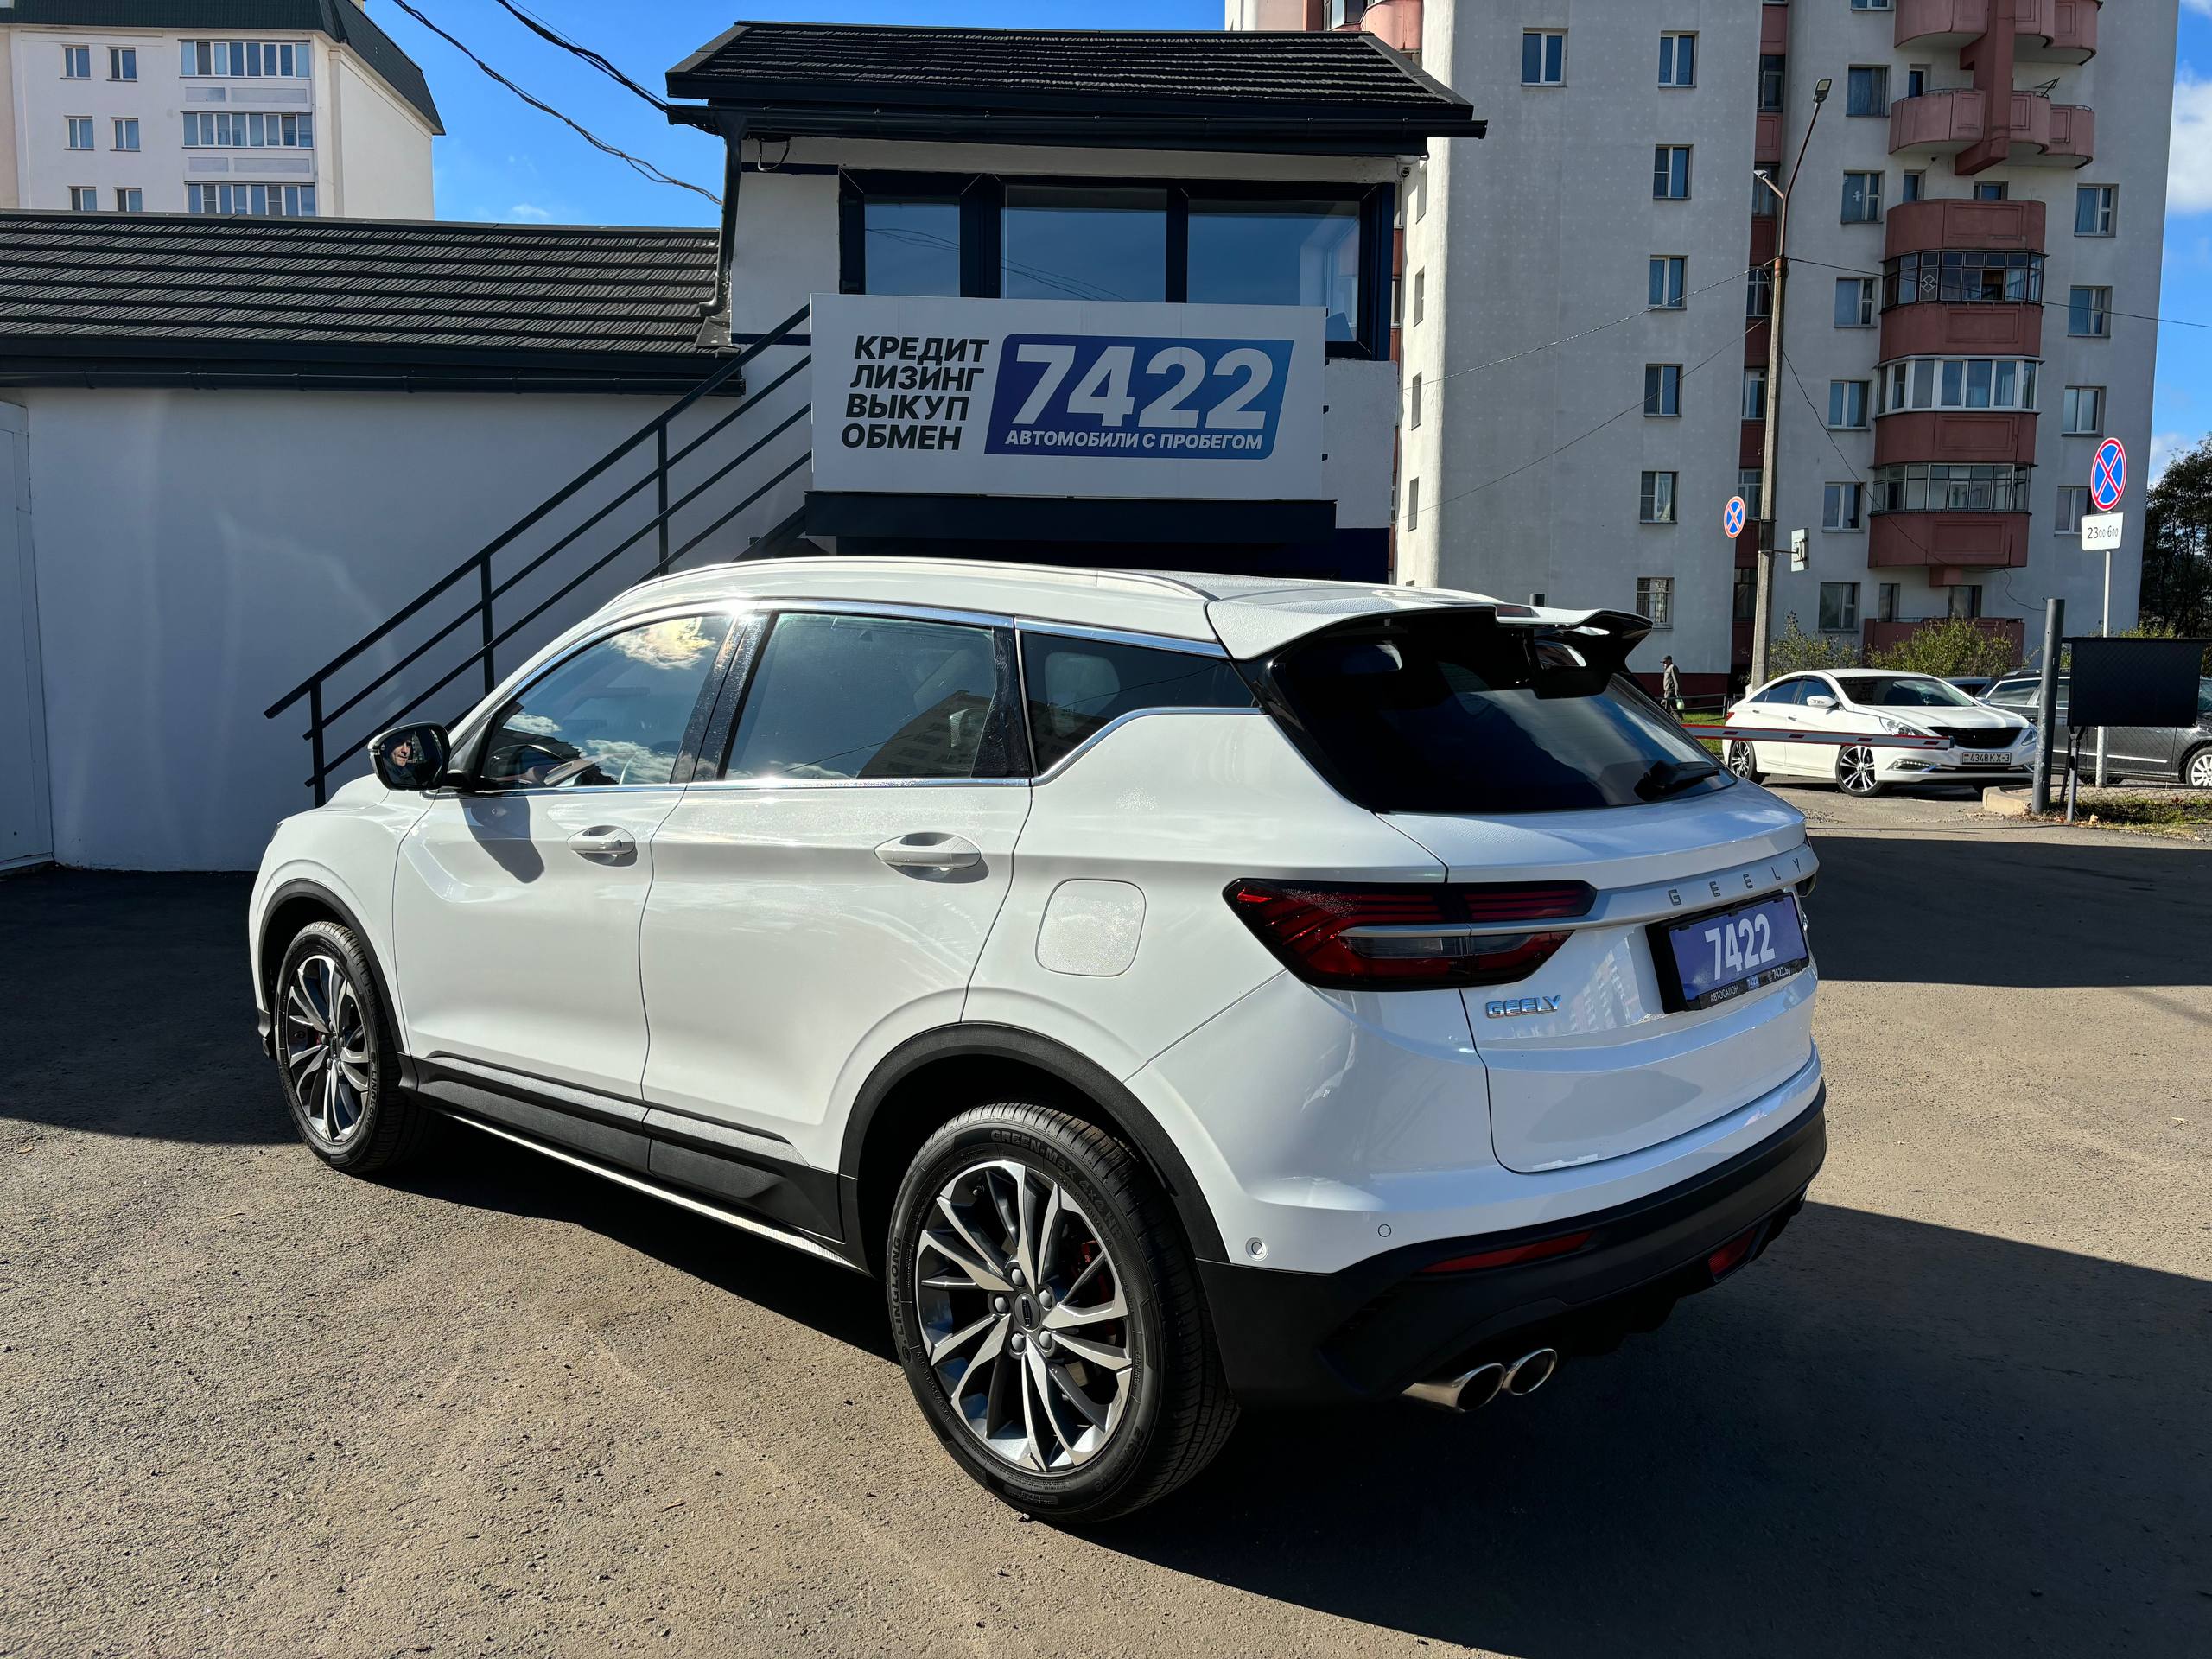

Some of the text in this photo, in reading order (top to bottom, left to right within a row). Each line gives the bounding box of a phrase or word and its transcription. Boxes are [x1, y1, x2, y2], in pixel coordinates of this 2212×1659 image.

[854, 335, 990, 366] КРЕДИТ
[849, 365, 985, 391] ЛИЗИНГ
[1011, 344, 1274, 429] 7422
[845, 393, 969, 421] ВЫКУП
[842, 423, 963, 451] ОБМЕН
[1005, 429, 1263, 451] АВТОМОБИЛИ С ПРОБЕГОМ
[1668, 858, 1801, 906] GEELY
[1704, 913, 1776, 981] 7422
[1485, 995, 1561, 1019] GEELY
[1709, 985, 1739, 1003] АВТОСАЛОН
[891, 1236, 904, 1337] LINGLONG
